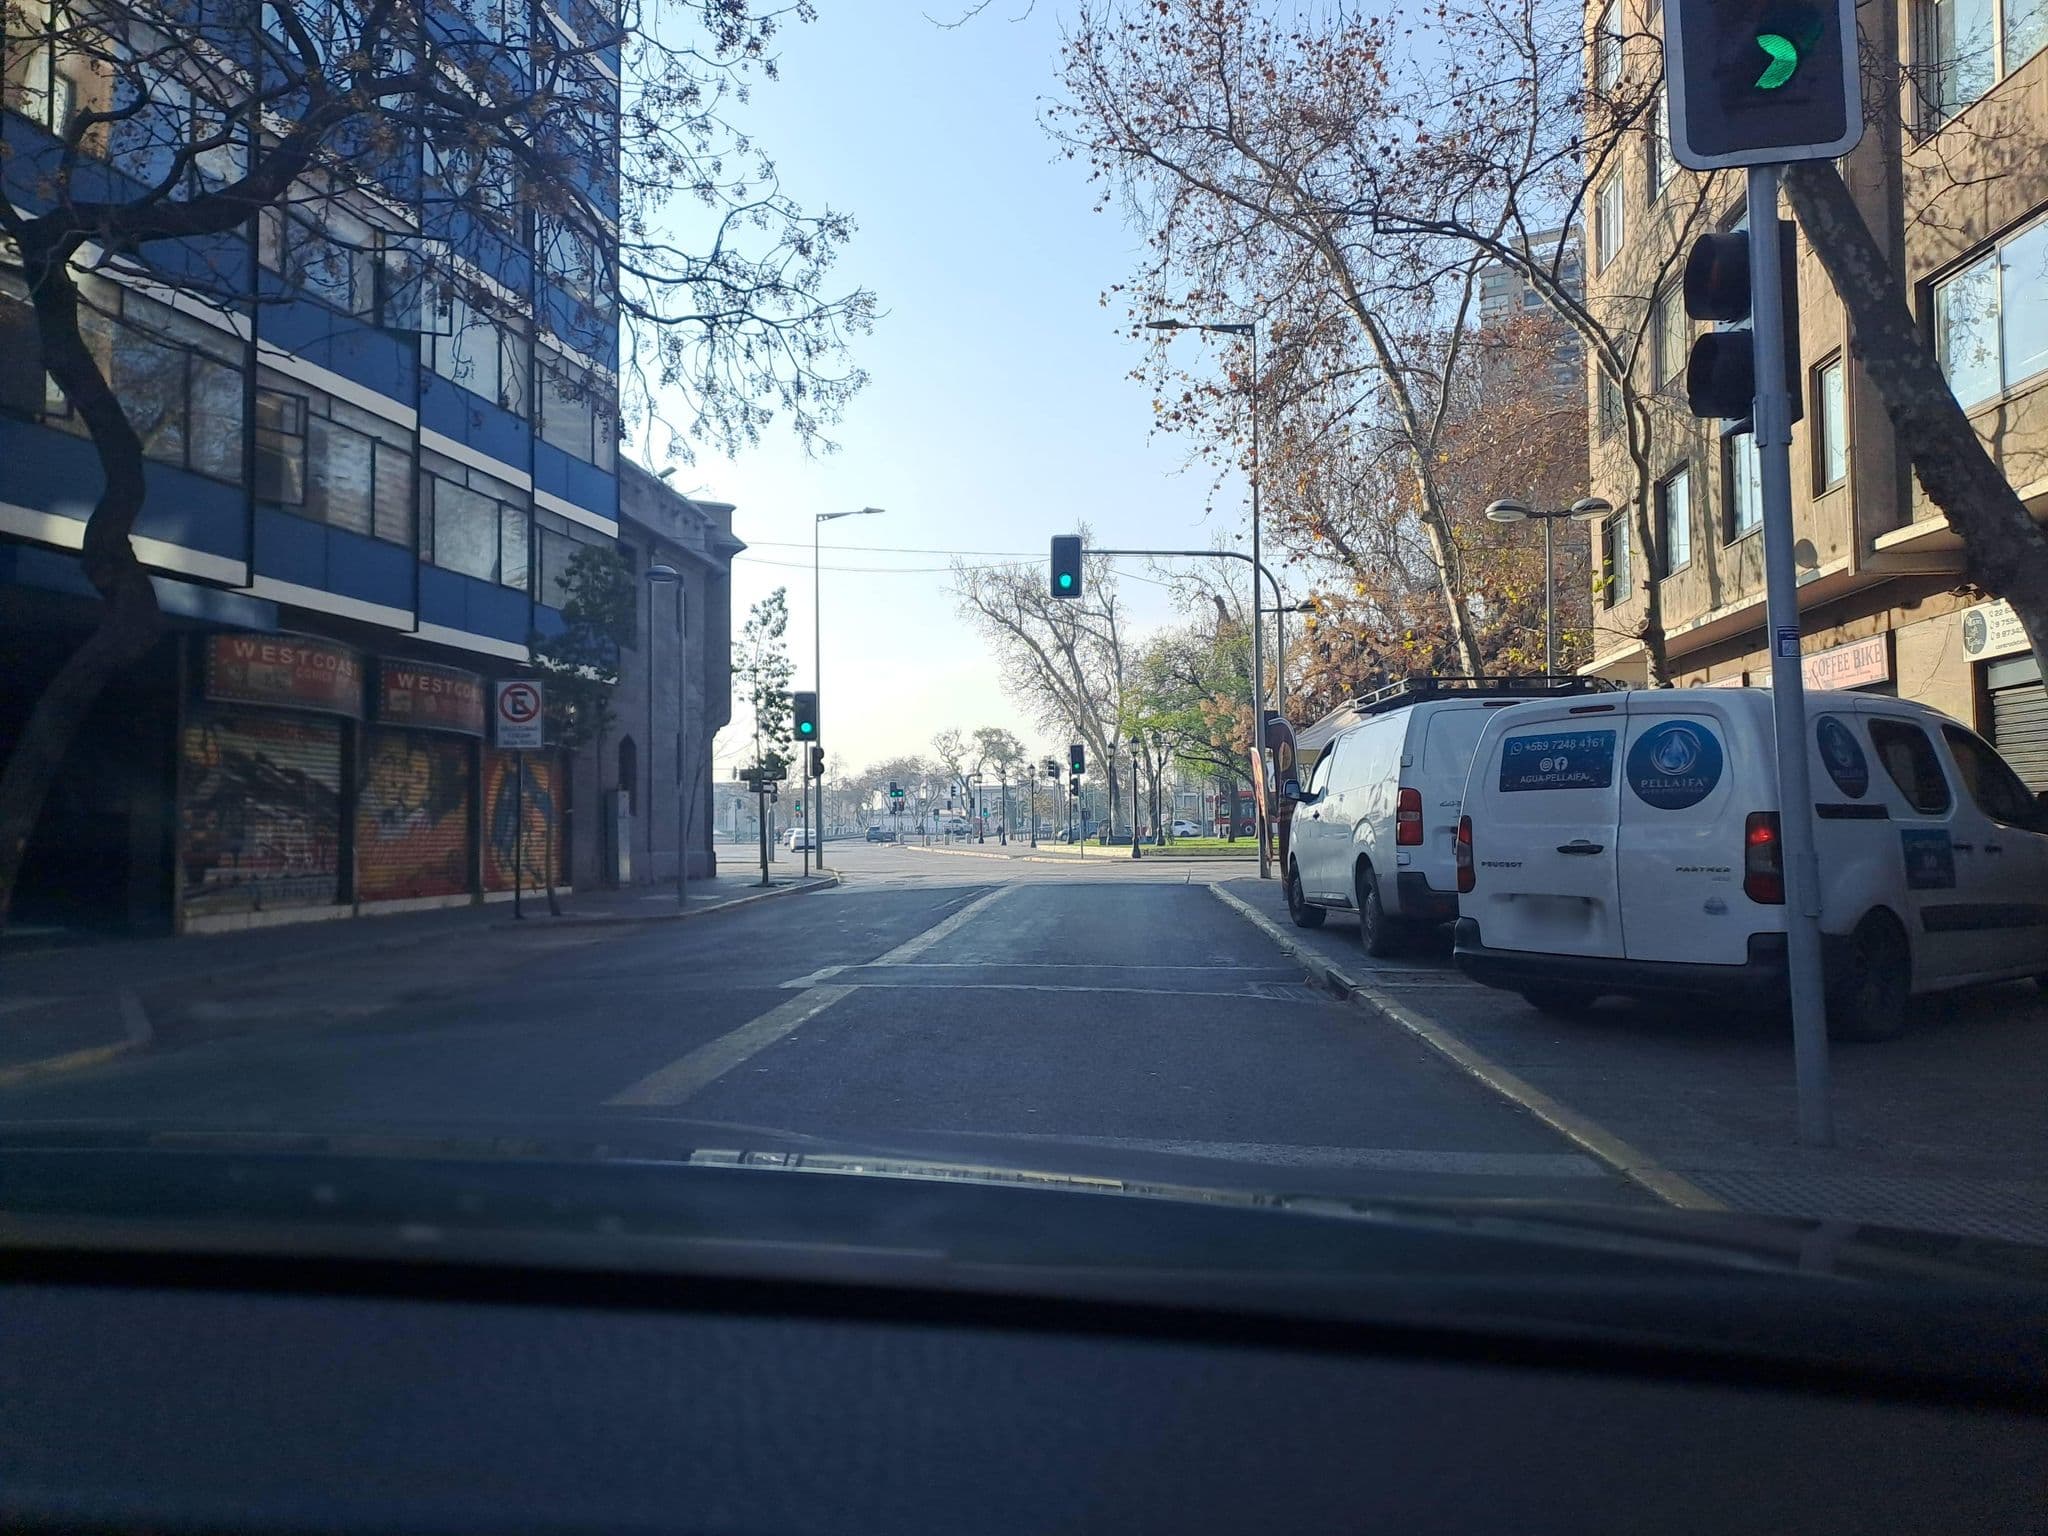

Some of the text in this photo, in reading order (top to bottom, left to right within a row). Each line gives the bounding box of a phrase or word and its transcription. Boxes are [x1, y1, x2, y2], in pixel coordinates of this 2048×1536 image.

[1812, 652, 1850, 678] COFFEE
[1853, 643, 1882, 669] BIKE
[1552, 739, 1576, 750] 7248
